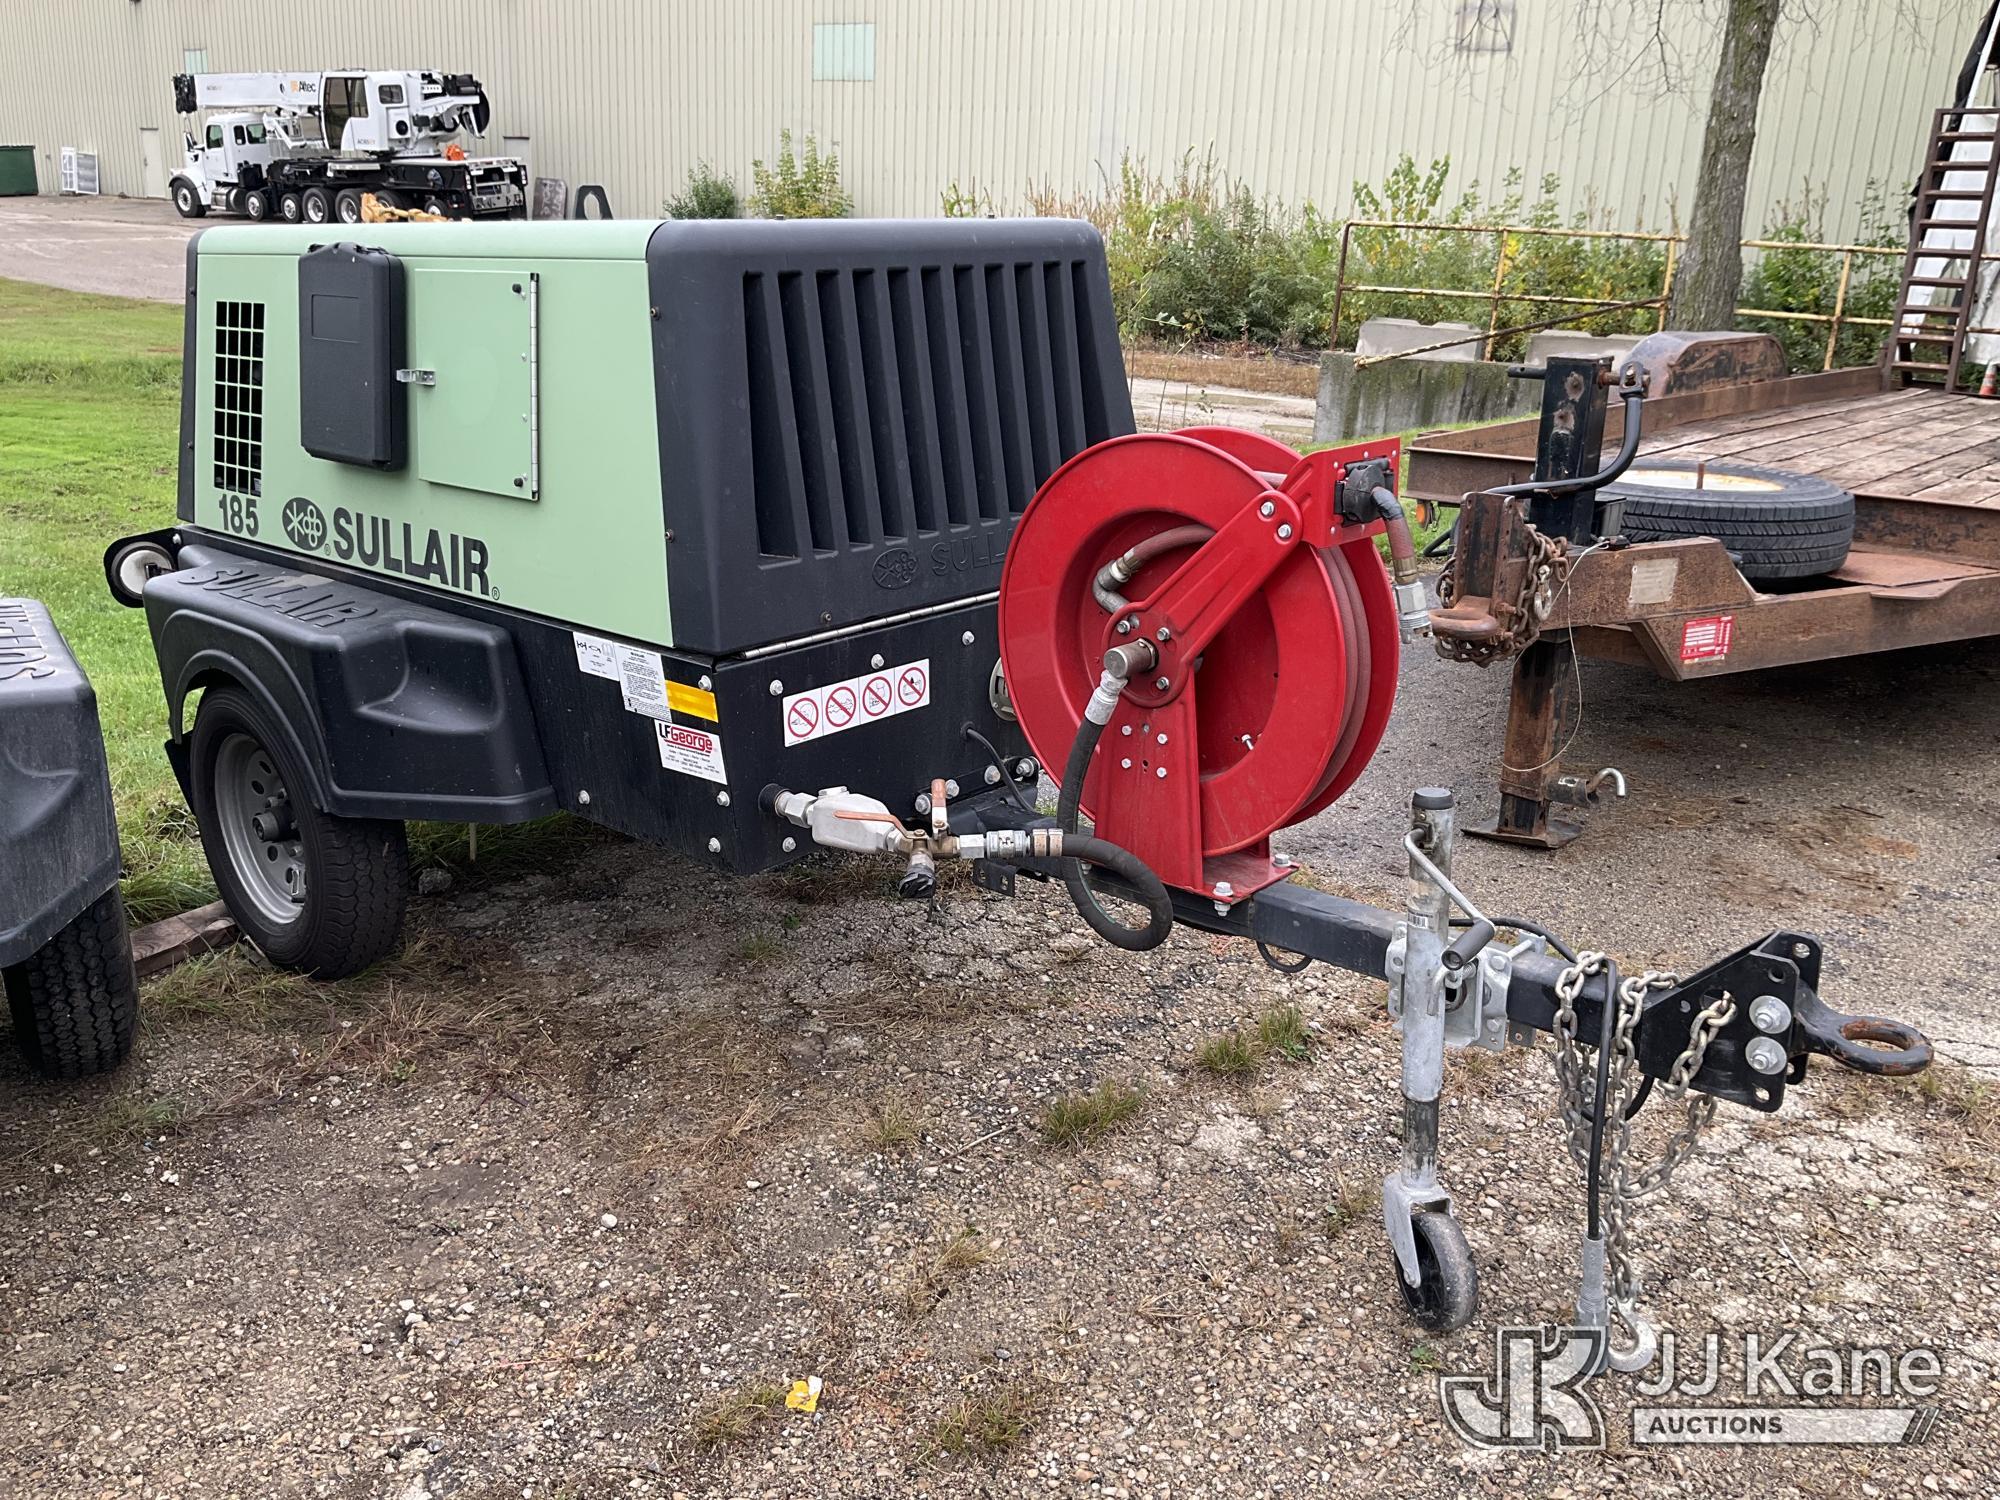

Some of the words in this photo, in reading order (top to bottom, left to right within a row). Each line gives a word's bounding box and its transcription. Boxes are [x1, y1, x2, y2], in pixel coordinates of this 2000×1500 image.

[298, 80, 316, 92] Altec
[218, 493, 260, 538] 185
[332, 506, 490, 597] SULLAIR
[930, 528, 1014, 577] SULL
[177, 567, 378, 628] SULLAIR
